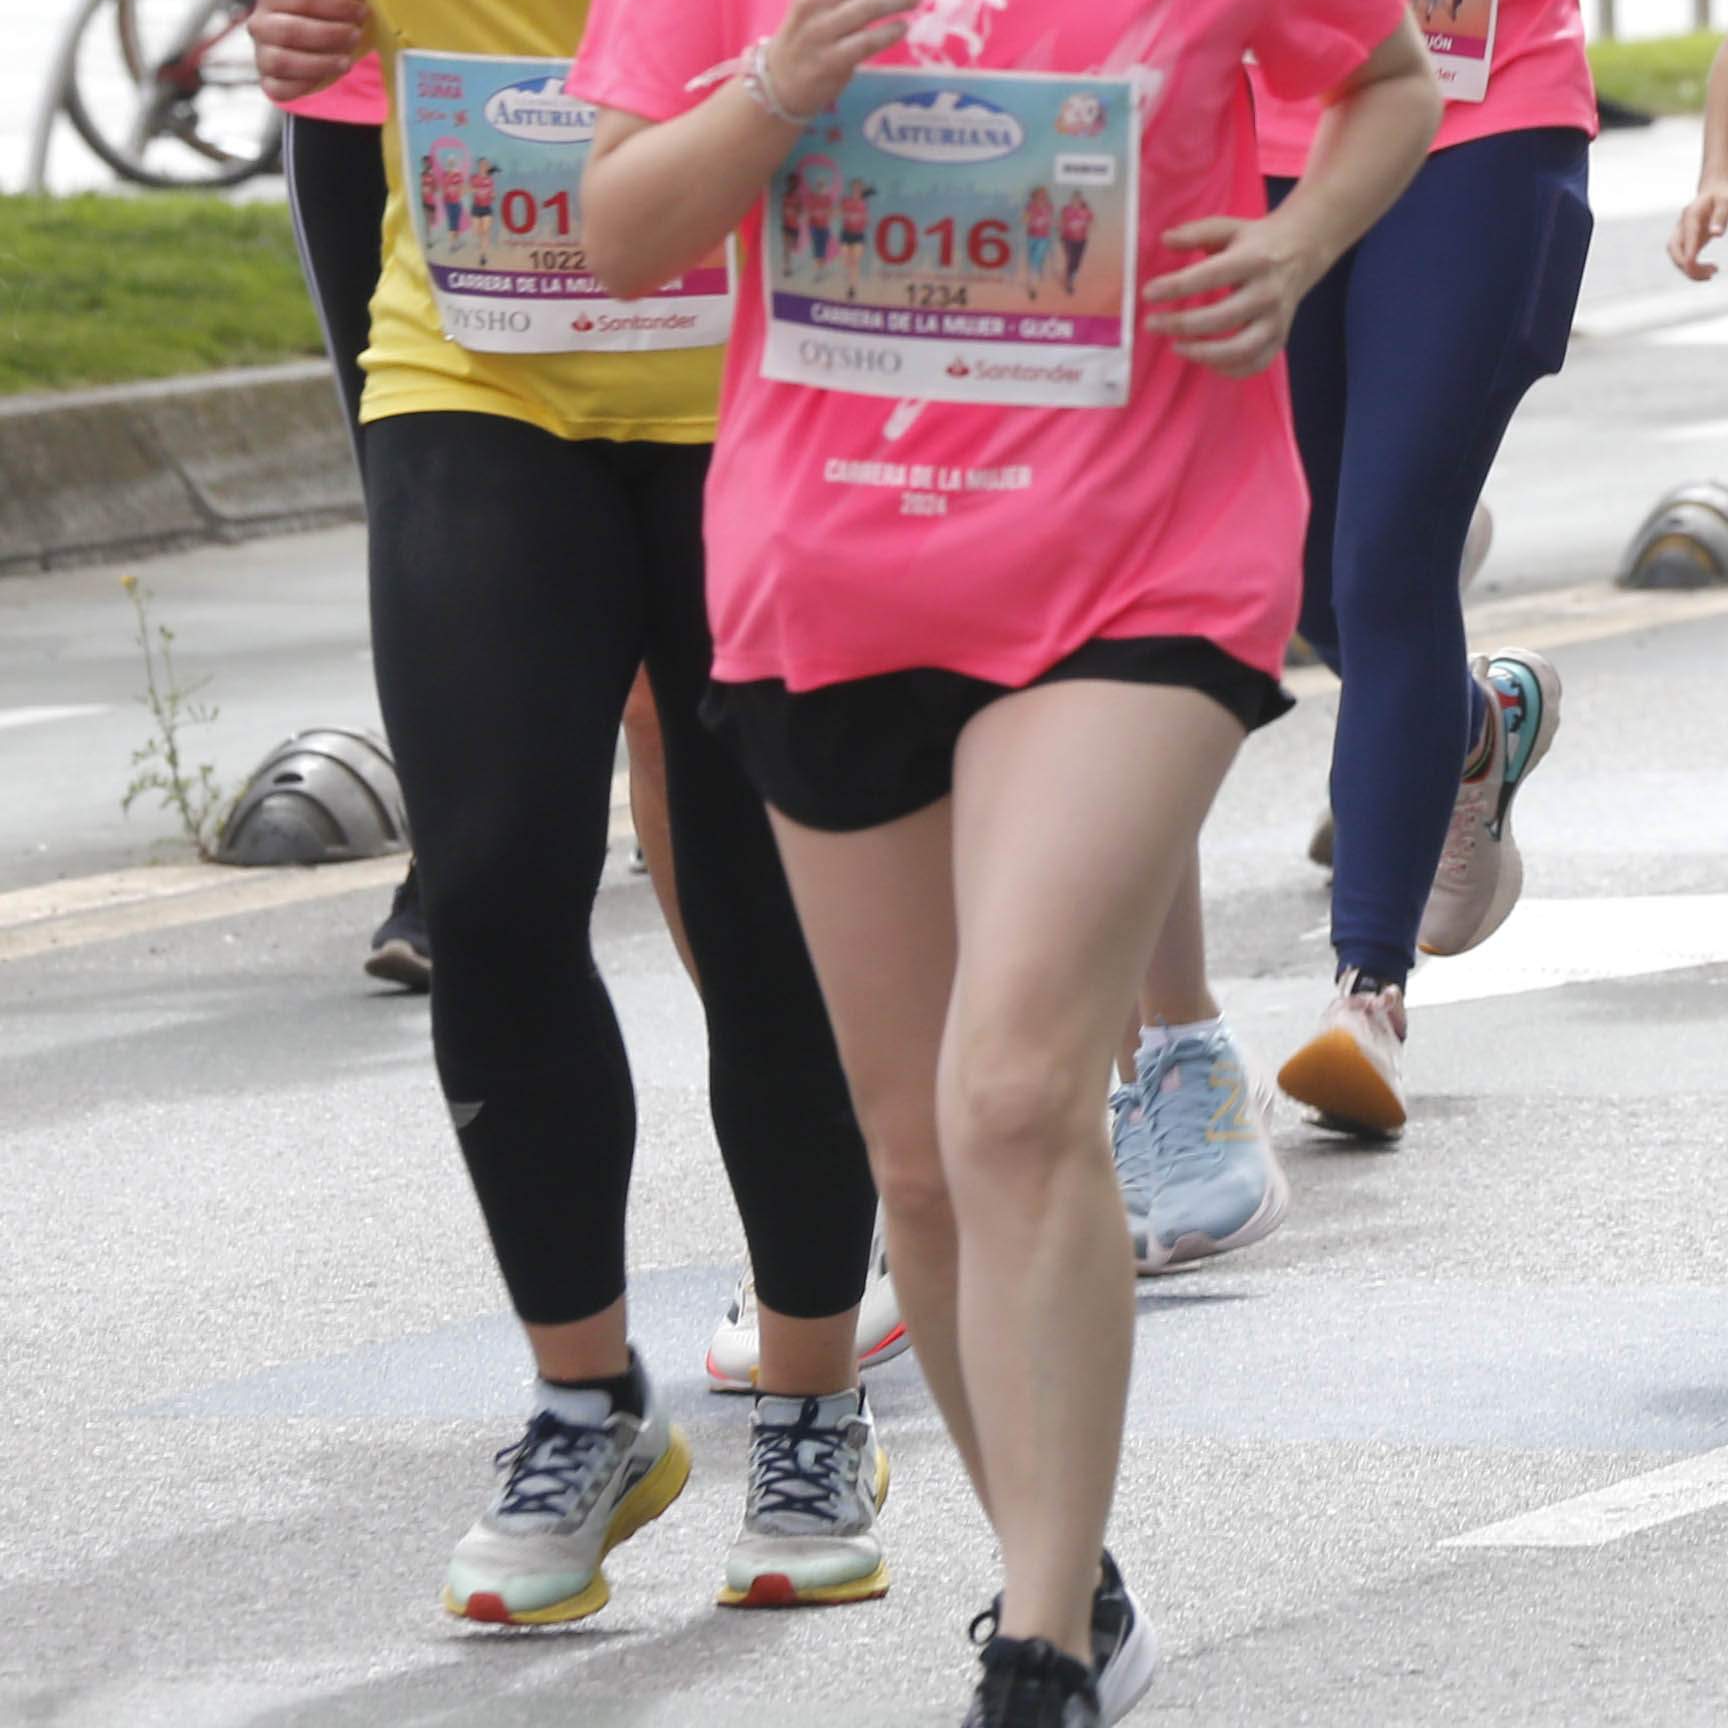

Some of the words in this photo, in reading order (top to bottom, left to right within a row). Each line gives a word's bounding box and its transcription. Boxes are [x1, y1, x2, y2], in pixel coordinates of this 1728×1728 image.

[877, 118, 1014, 148] ASTURIANA
[875, 213, 1013, 269] 016
[530, 250, 586, 270] 1022
[449, 272, 514, 292] CARRERA
[516, 274, 537, 292] DE
[540, 276, 562, 293] LA
[905, 285, 967, 306] 1234
[597, 312, 696, 333] Santander
[811, 303, 881, 329] CARRERA
[887, 311, 914, 332] DE
[917, 313, 938, 332] LA
[943, 316, 1005, 336] MUJER
[800, 339, 903, 373] OYSHO
[824, 458, 906, 486] CARRERA
[909, 464, 935, 488] DE
[938, 466, 962, 491] LA
[966, 464, 1032, 490] MUJER
